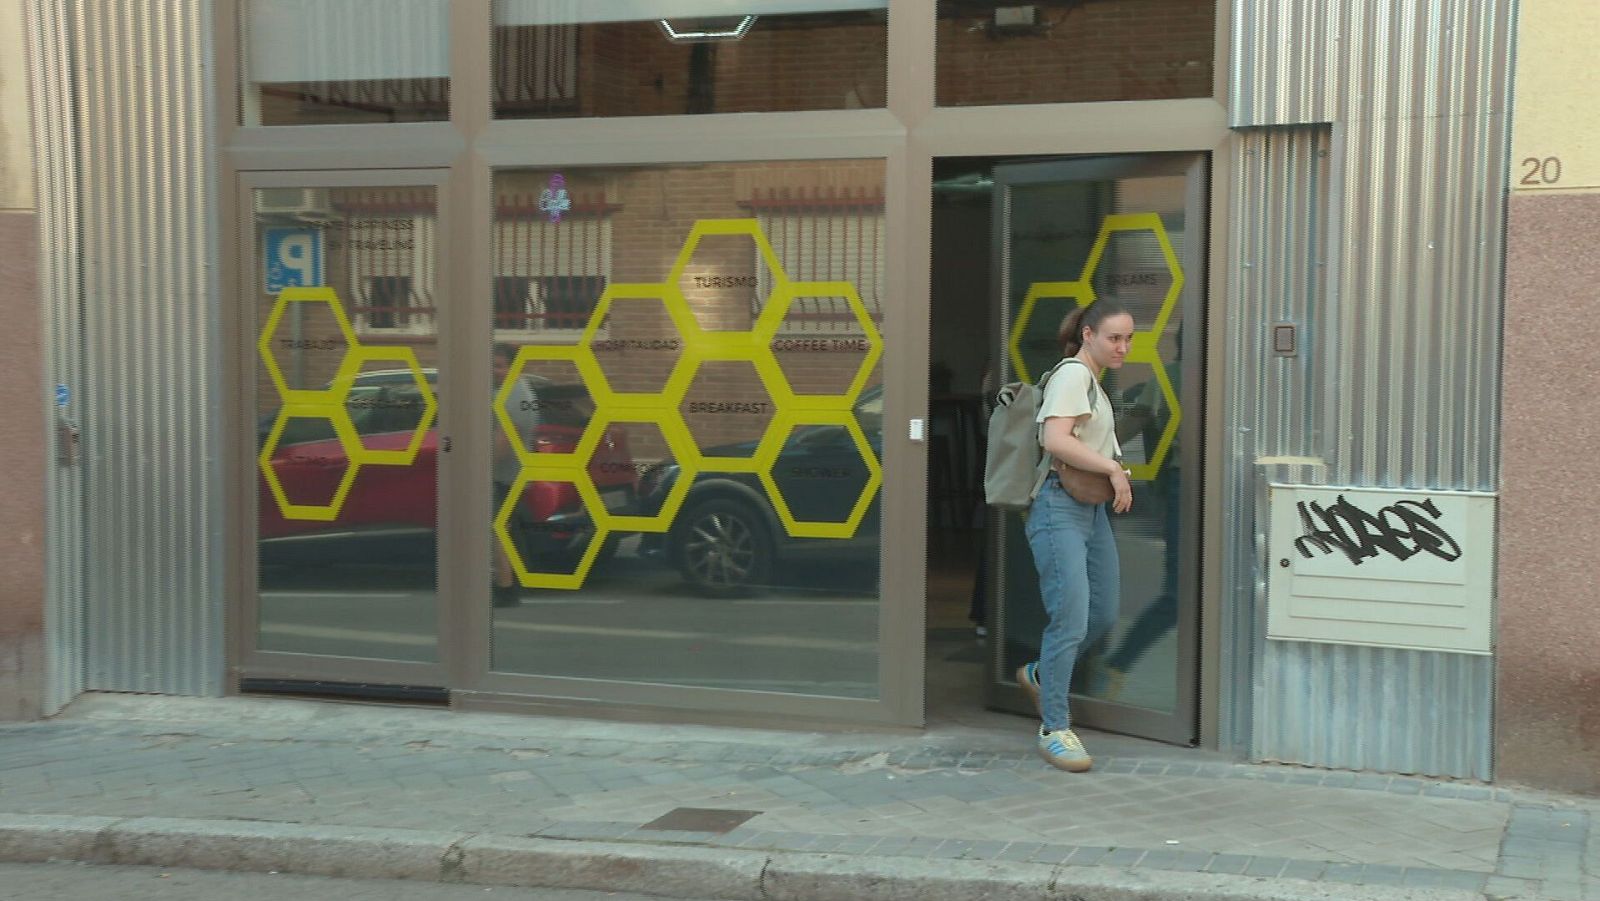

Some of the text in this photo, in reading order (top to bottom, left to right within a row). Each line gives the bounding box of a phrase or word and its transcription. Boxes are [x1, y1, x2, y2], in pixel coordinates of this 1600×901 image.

[1519, 156, 1562, 185] 20
[693, 275, 757, 288] TURISMO
[773, 339, 866, 352] COFFEE TIME
[688, 402, 769, 414] BREAKFAST
